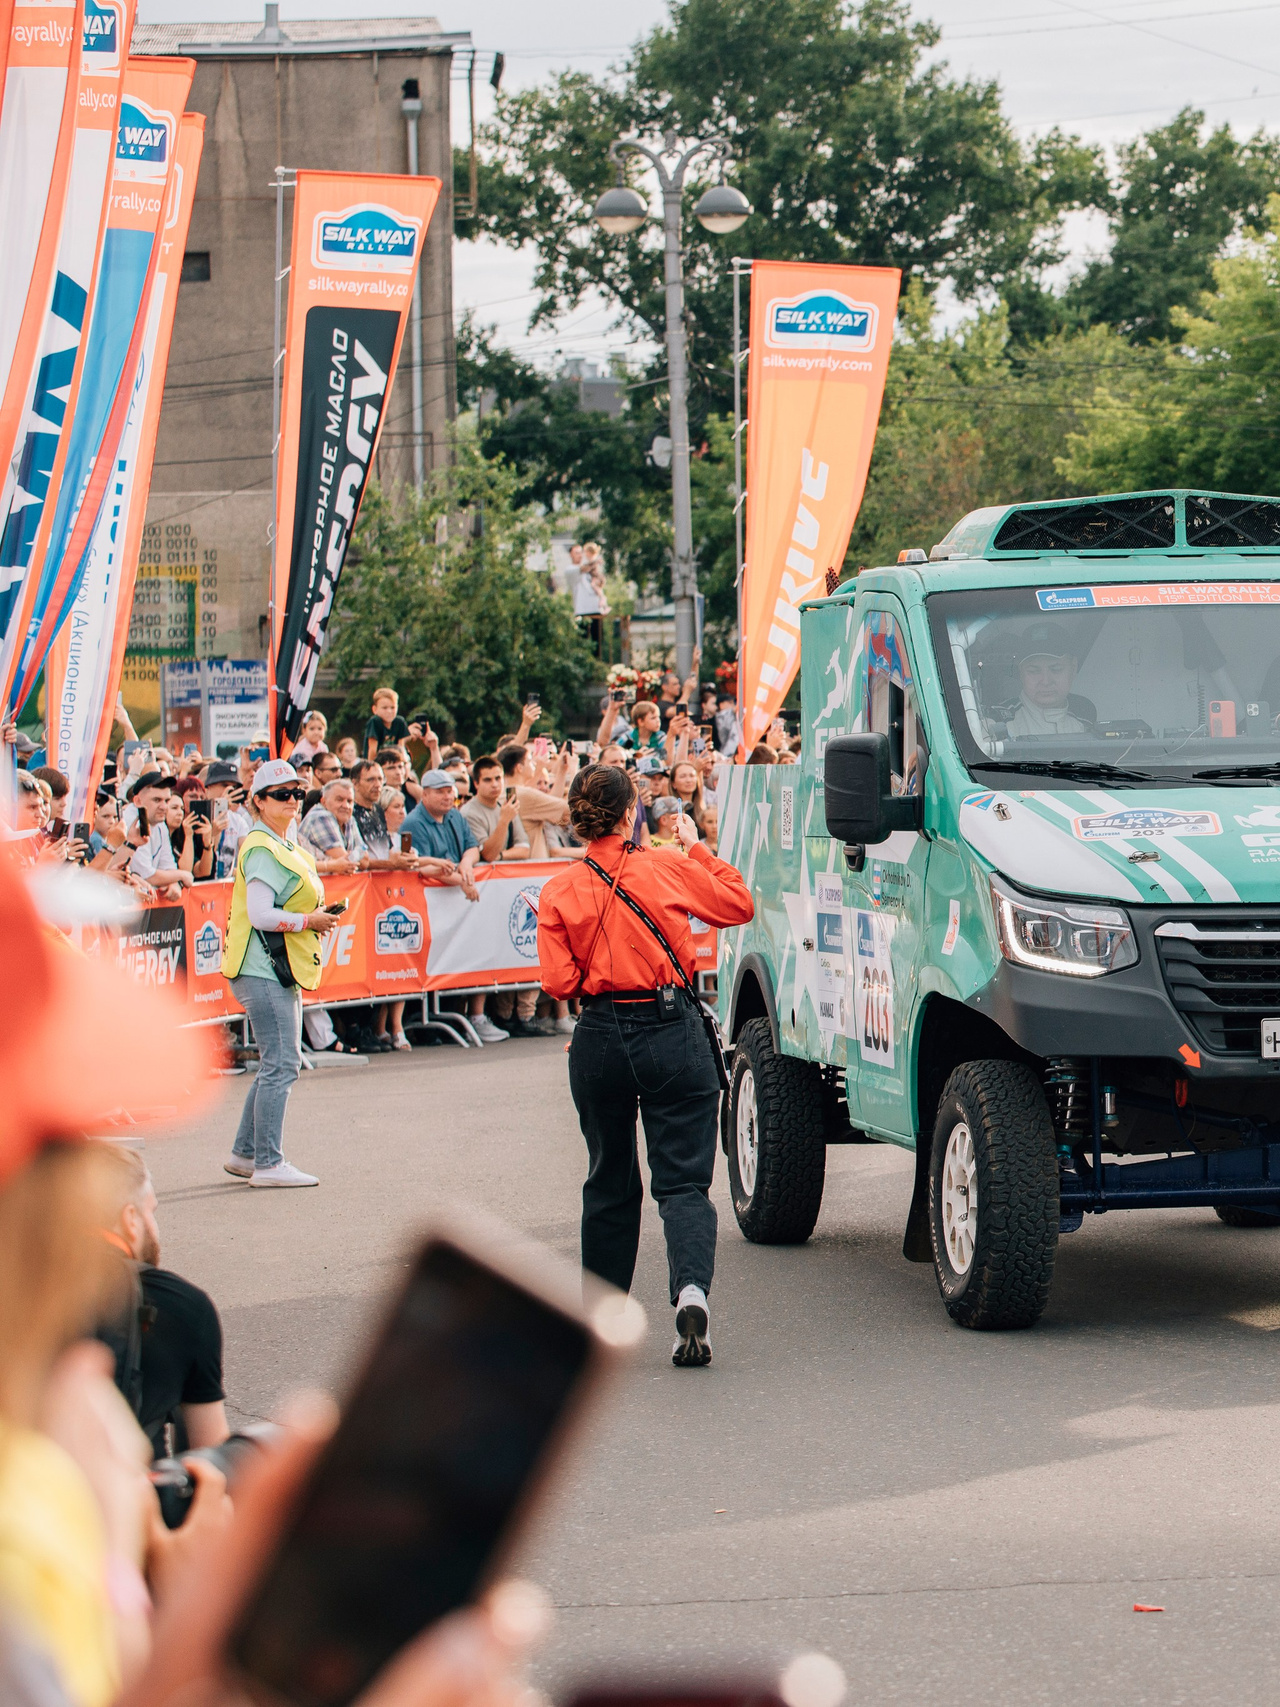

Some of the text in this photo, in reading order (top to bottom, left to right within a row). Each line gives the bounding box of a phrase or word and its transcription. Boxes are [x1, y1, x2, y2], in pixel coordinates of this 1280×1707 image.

[124, 127, 166, 147] WAY
[324, 226, 415, 245] SILK WAY
[346, 242, 394, 252] RALLY
[777, 311, 867, 327] SILK WAY
[798, 324, 844, 332] RALLY
[1158, 587, 1190, 595] SILK
[1228, 586, 1272, 594] RALLY
[1101, 595, 1152, 604] RUSSIA
[1189, 594, 1243, 602] EDITION
[59, 610, 90, 752] (Акционерное
[1088, 816, 1202, 827] SILK WAY
[1132, 829, 1165, 837] 203
[819, 1001, 835, 1019] KAMAZ
[863, 965, 890, 1054] 203
